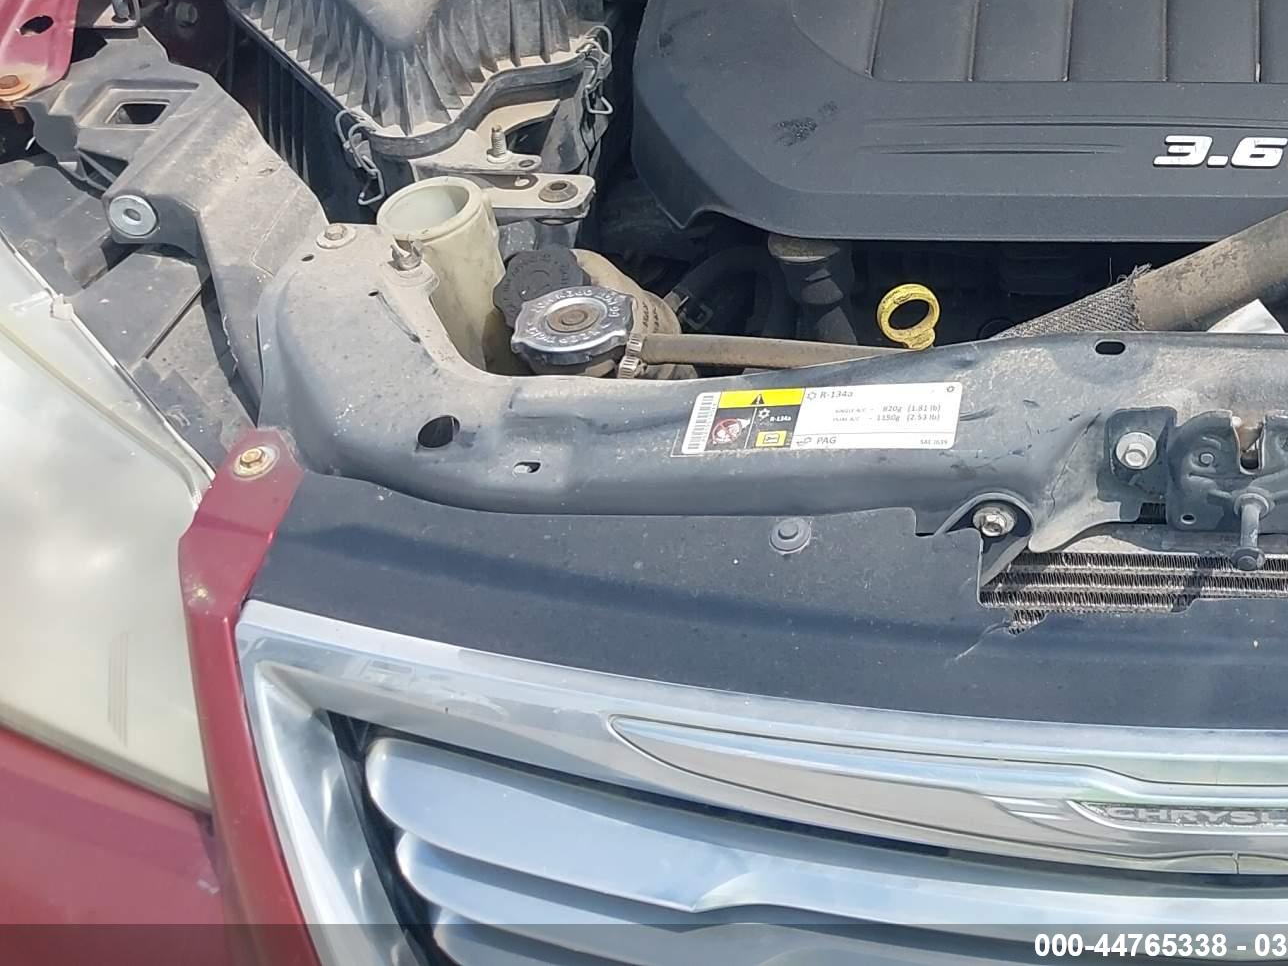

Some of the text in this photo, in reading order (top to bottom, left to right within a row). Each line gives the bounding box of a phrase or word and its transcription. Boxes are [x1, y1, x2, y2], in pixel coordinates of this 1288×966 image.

[820, 390, 853, 400] R-134a
[907, 404, 928, 413] (1.81
[929, 404, 941, 413] lb)
[906, 413, 927, 423] (2.53
[816, 436, 837, 445] PAG
